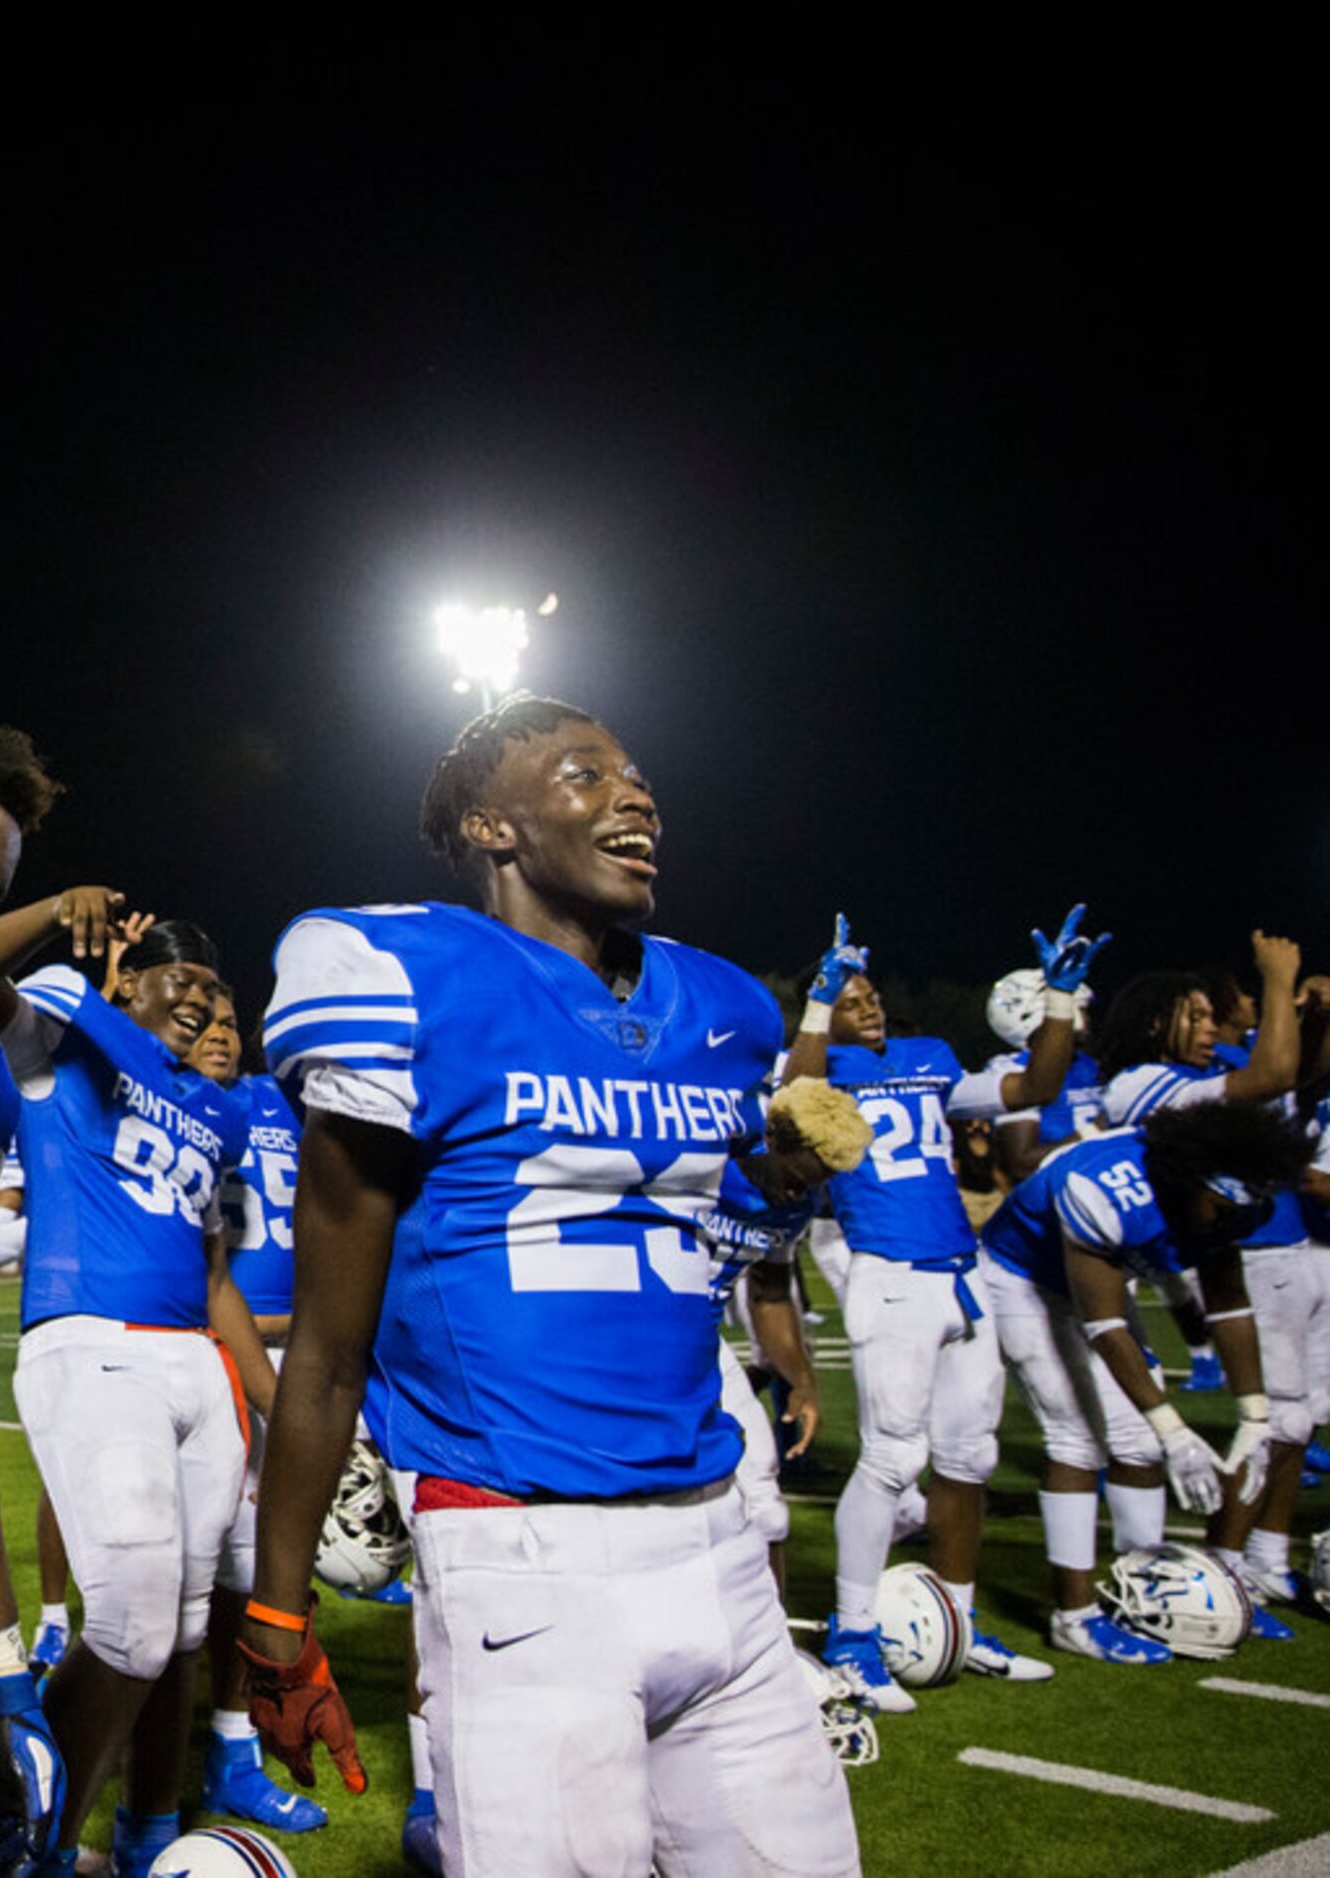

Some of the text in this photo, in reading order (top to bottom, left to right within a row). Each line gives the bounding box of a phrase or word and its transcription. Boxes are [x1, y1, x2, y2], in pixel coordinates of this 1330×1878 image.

[113, 1071, 224, 1162] PANTHERS
[858, 1093, 954, 1183] 24
[113, 1114, 214, 1228] 90
[1098, 1160, 1154, 1212] 52
